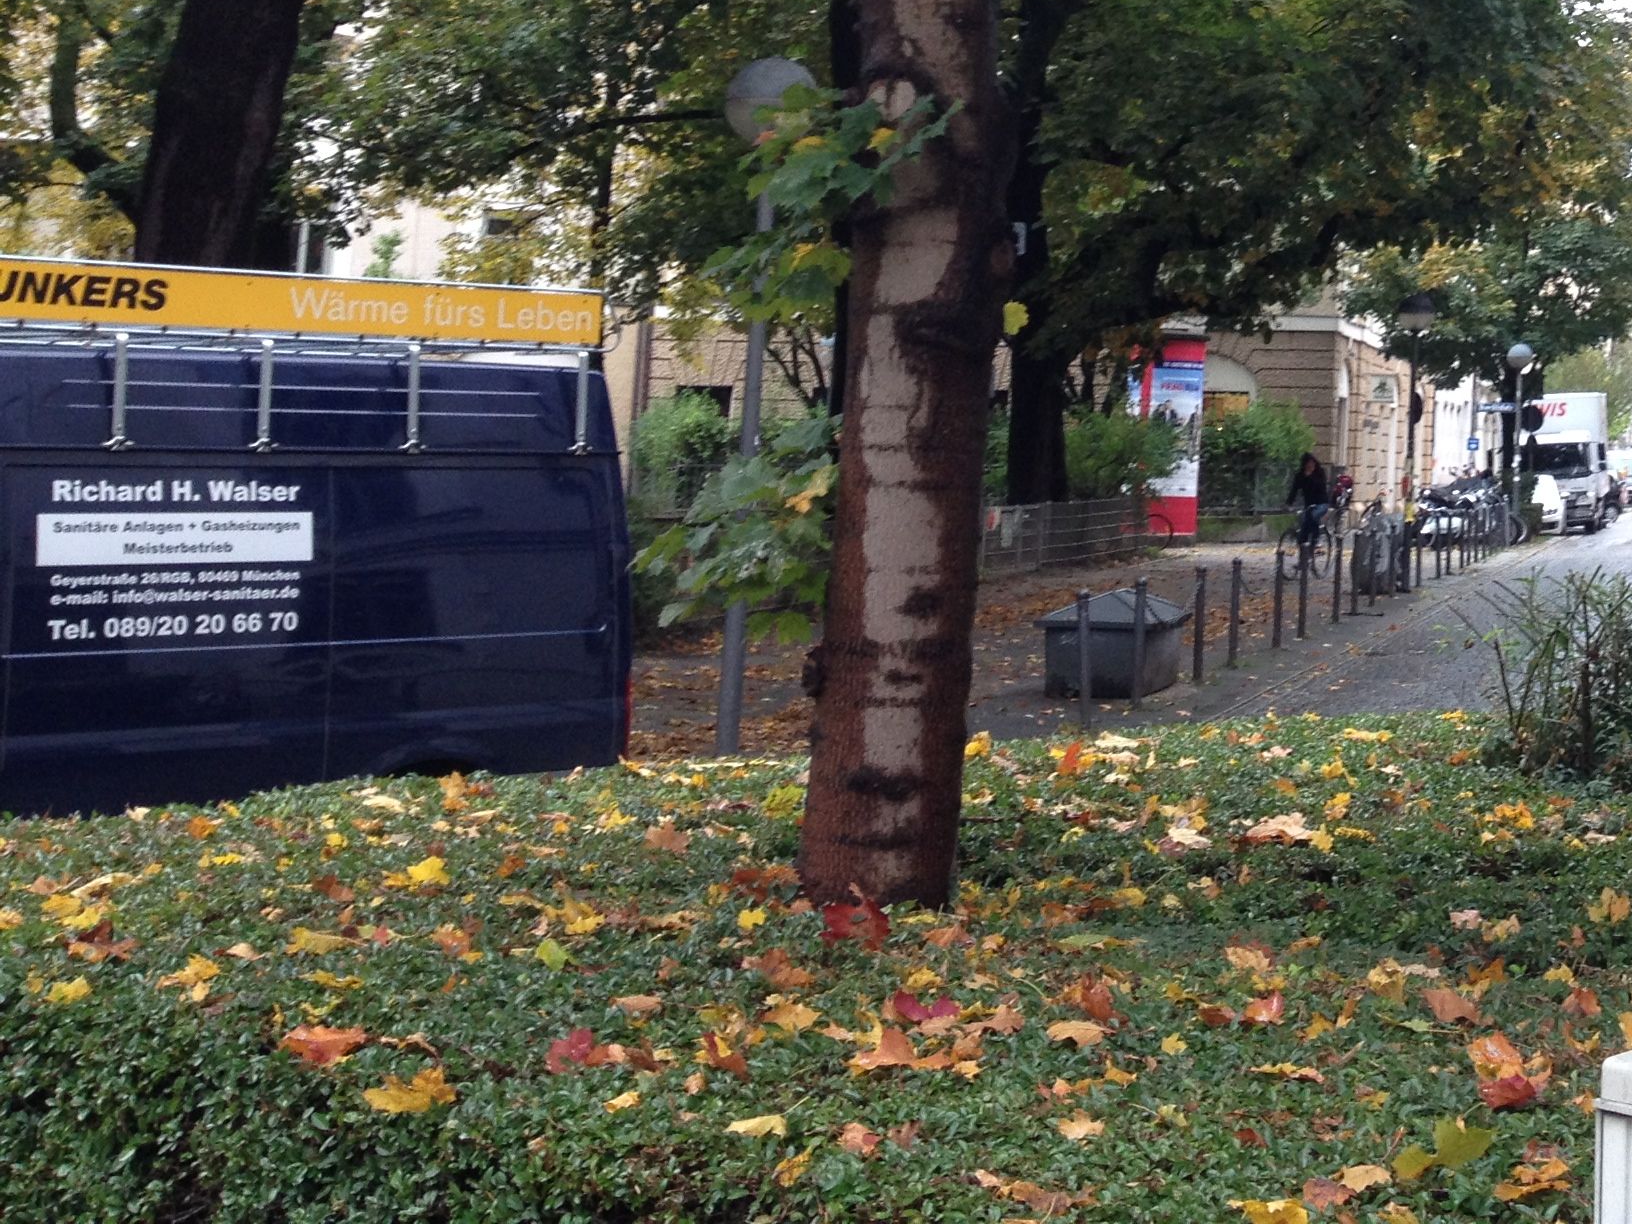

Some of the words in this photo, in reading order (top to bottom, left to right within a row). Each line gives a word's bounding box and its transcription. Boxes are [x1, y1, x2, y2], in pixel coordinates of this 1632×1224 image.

[289, 287, 409, 325] Wärme
[423, 295, 485, 327] fürs
[498, 298, 593, 331] Leben
[1535, 402, 1567, 417] VIS
[52, 479, 163, 502] Richard
[171, 480, 201, 502] H.
[207, 480, 301, 502] Walser
[53, 520, 119, 534] Sanitäre
[122, 520, 185, 535] Anlagen
[201, 519, 301, 534] Gasheizungen
[123, 541, 233, 556] Meisterbetrieb
[50, 573, 138, 589] Geyerstraße
[241, 569, 301, 582] München
[50, 590, 108, 606] e-mail:
[112, 585, 300, 604] info@walser-sanitaer.de
[47, 618, 97, 640] Tel.
[103, 615, 190, 639] 089/20
[194, 613, 226, 635] 20
[232, 611, 263, 633] 66
[268, 611, 300, 632] 70
